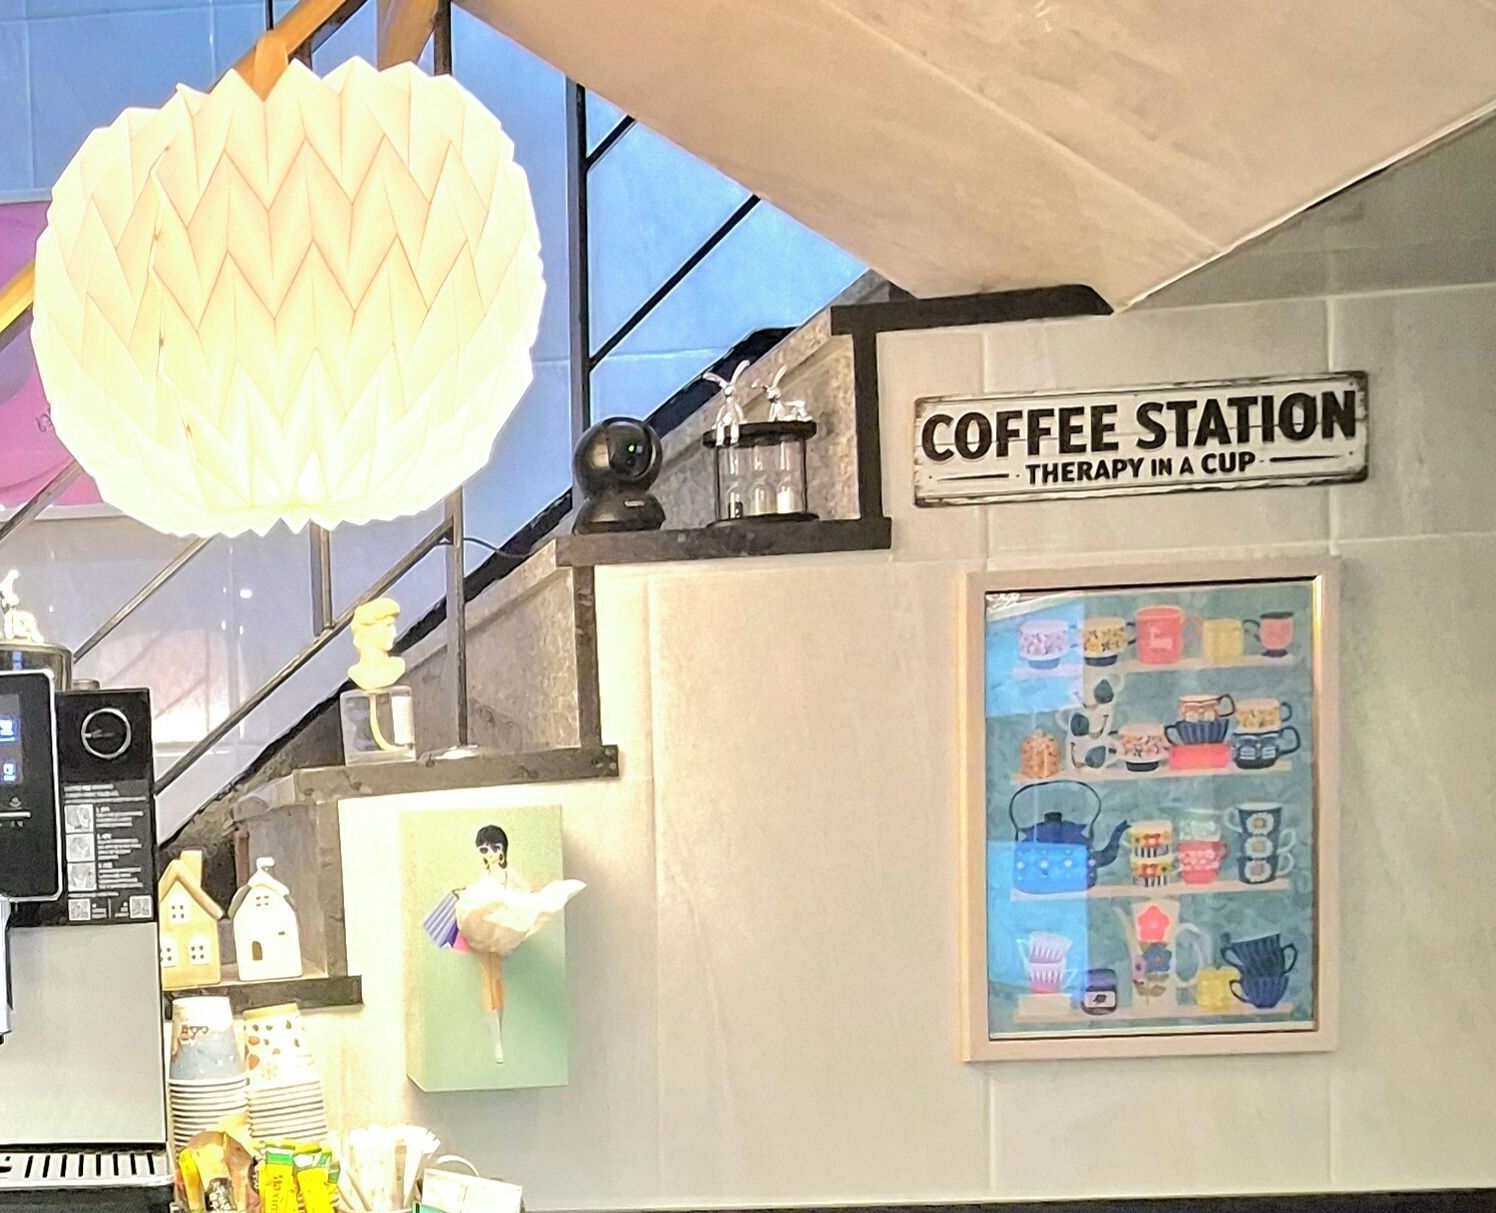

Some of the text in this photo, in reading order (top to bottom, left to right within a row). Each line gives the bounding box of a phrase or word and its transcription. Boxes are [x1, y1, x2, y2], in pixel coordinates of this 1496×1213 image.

[921, 389, 1358, 462] COFFEE STATION
[1025, 451, 1257, 485] THERAPY IN A CUP
